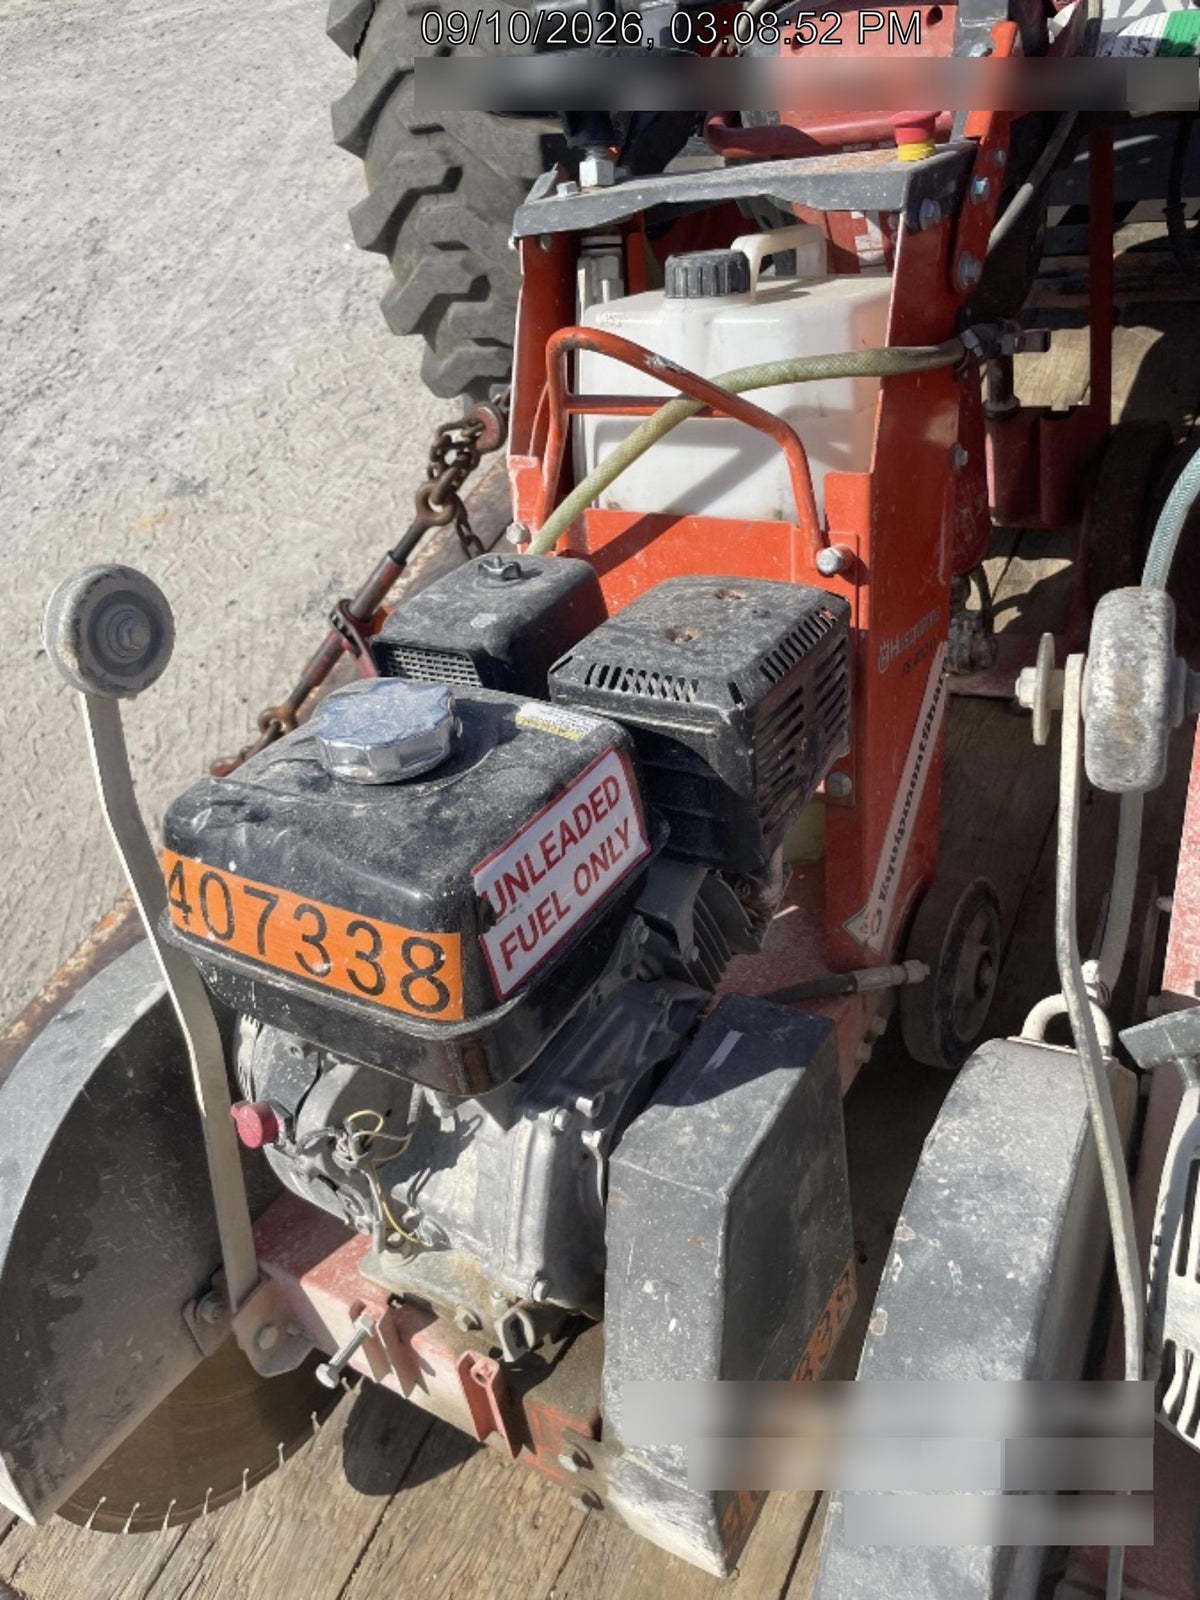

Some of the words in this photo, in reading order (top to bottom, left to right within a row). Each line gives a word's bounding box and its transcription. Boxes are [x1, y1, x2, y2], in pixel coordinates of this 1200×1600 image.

[480, 775, 621, 920] UNLEADED
[499, 890, 572, 972] FUEL
[573, 817, 632, 897] ONLY
[167, 860, 451, 1013] 407338
